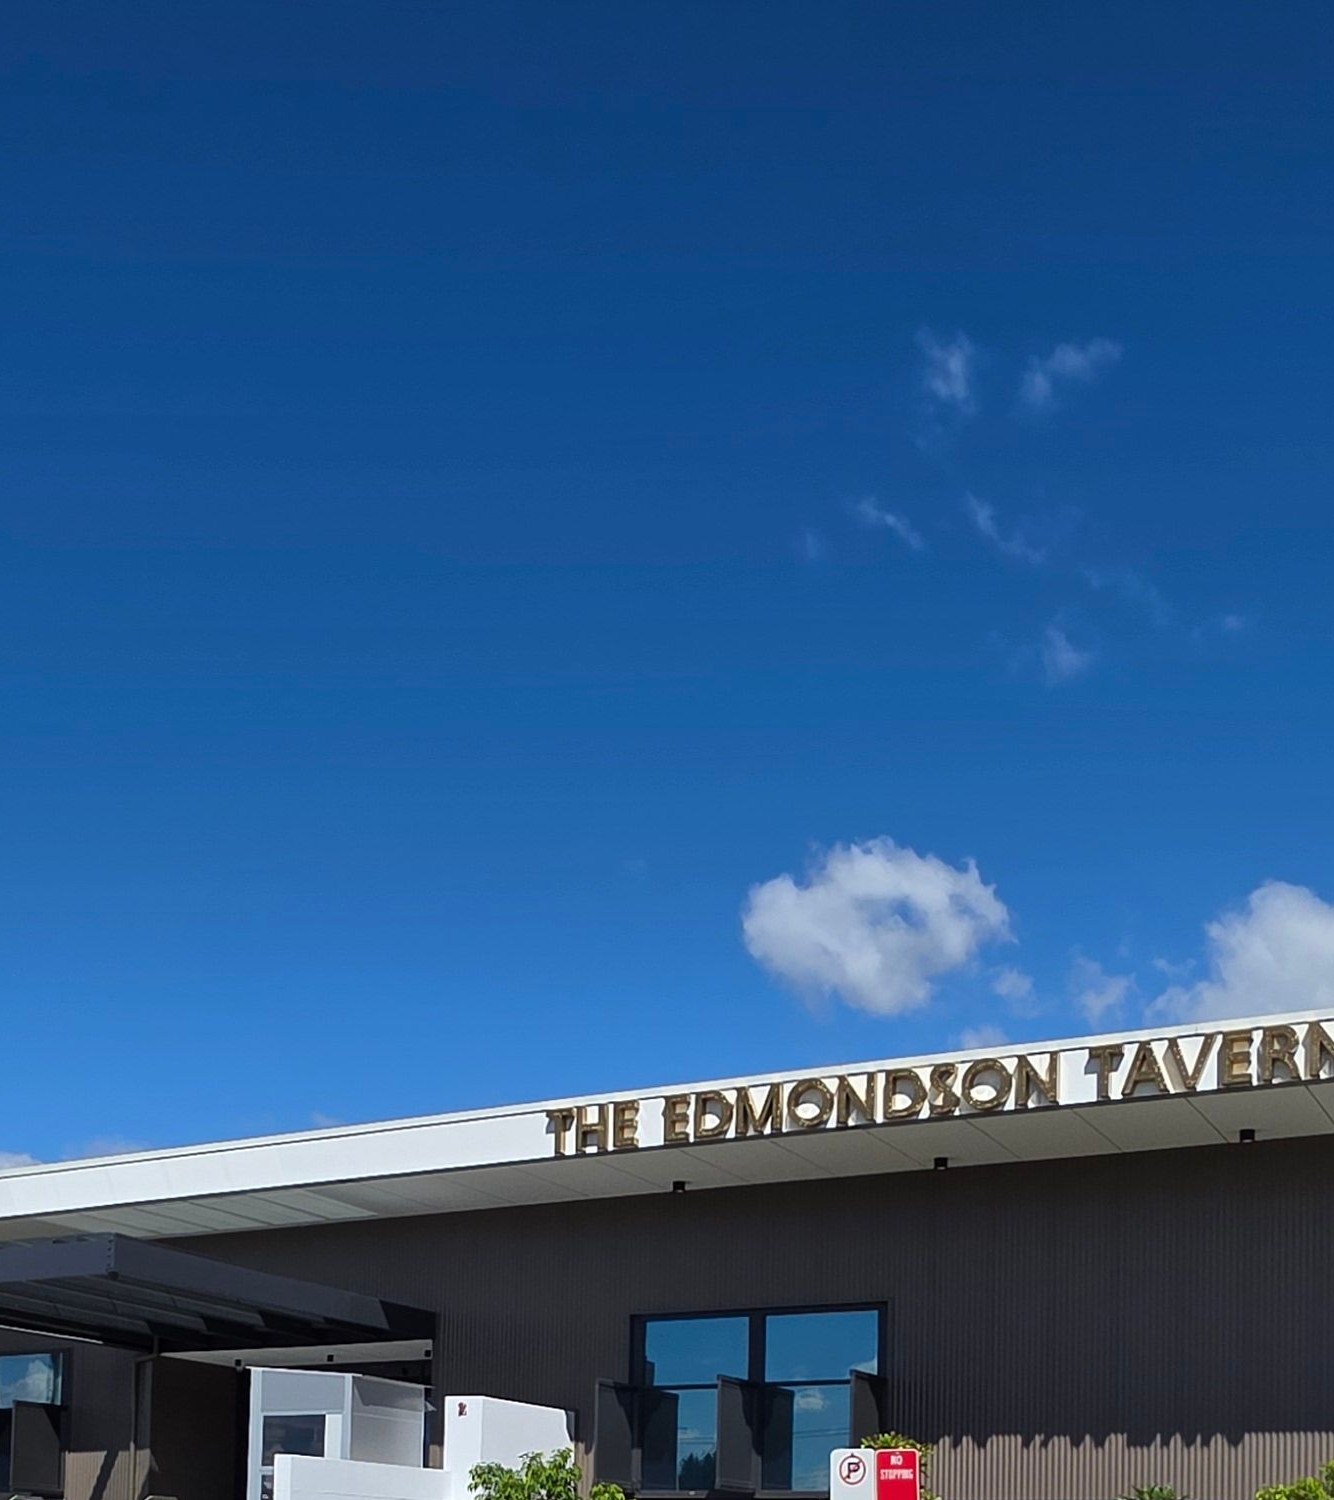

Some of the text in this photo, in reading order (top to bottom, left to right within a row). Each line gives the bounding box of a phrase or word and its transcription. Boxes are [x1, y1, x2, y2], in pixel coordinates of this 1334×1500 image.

[548, 1099, 640, 1156] THE
[662, 1050, 1060, 1144] EDMONDSON
[890, 1455, 903, 1466] NO
[880, 1468, 914, 1480] STOPPING
